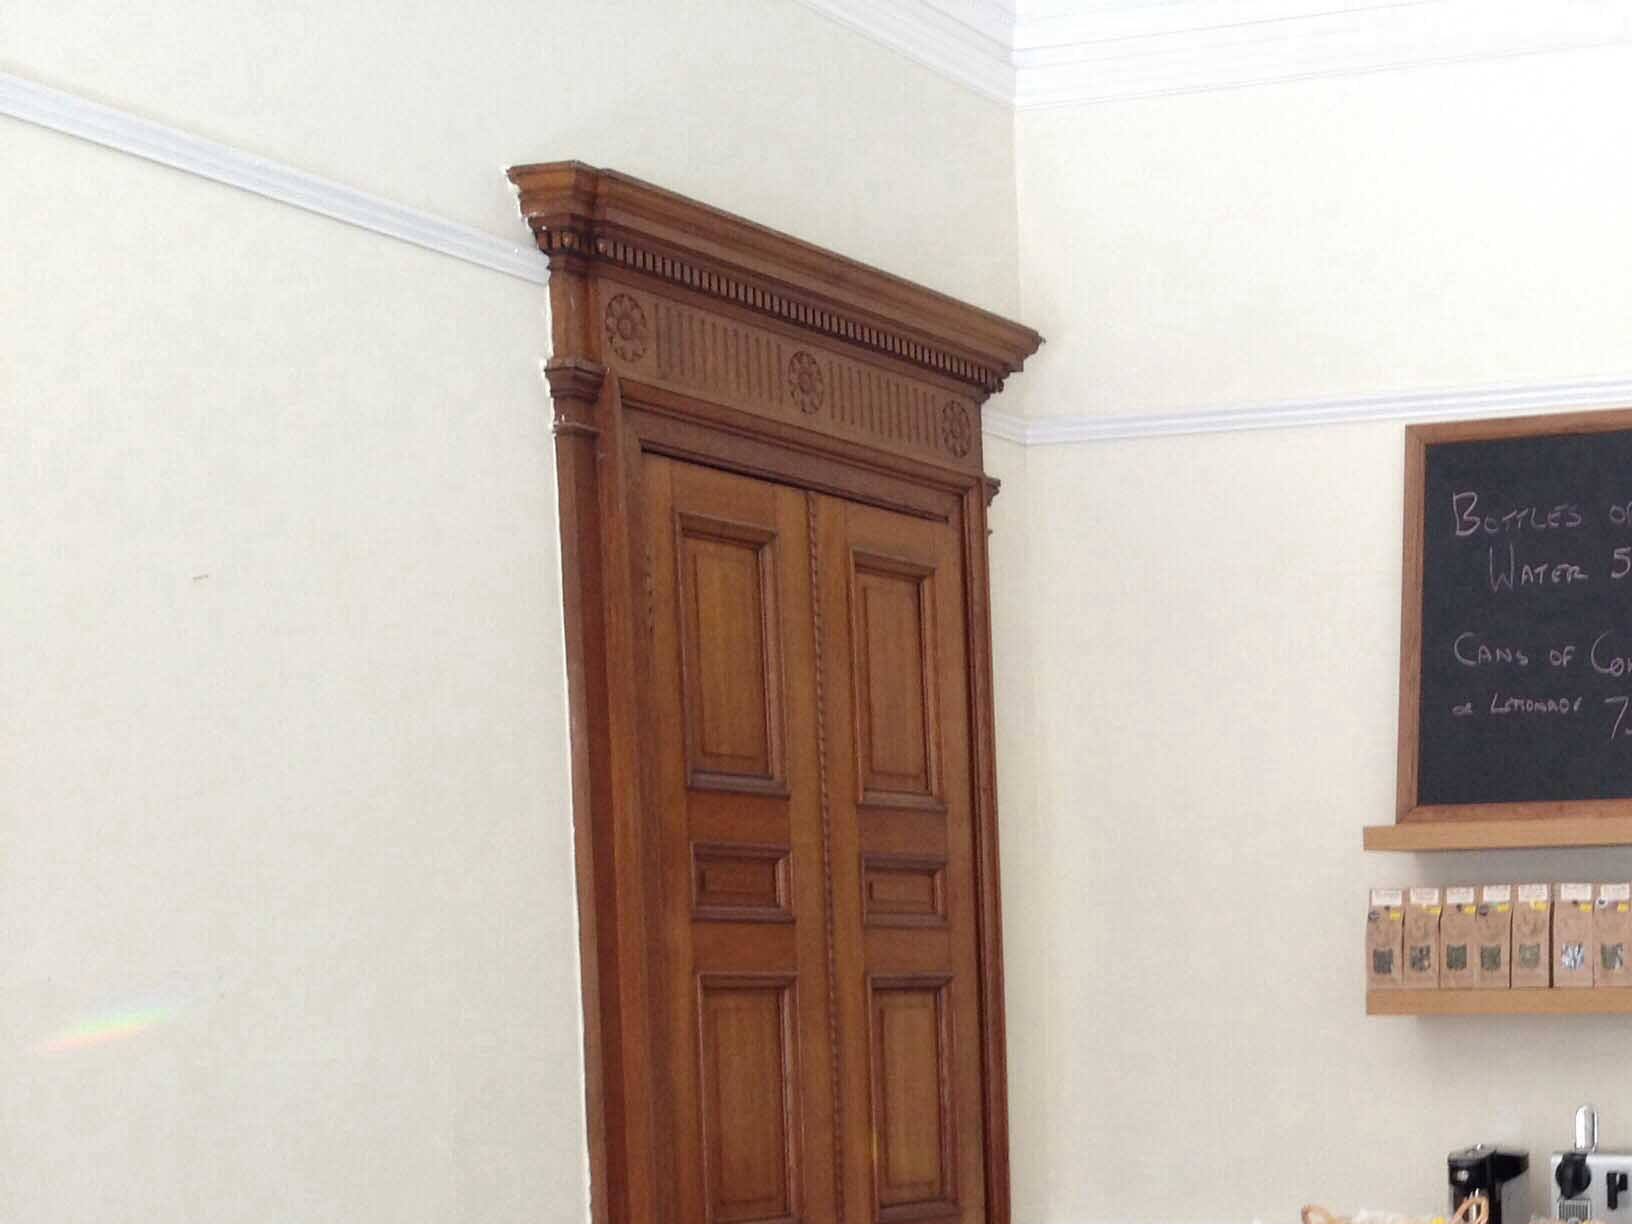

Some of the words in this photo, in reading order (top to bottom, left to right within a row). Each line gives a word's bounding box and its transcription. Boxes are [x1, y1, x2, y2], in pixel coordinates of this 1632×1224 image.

[1453, 491, 1582, 536] BOTTLES
[1489, 544, 1589, 591] WATER
[1454, 632, 1528, 666] CANS
